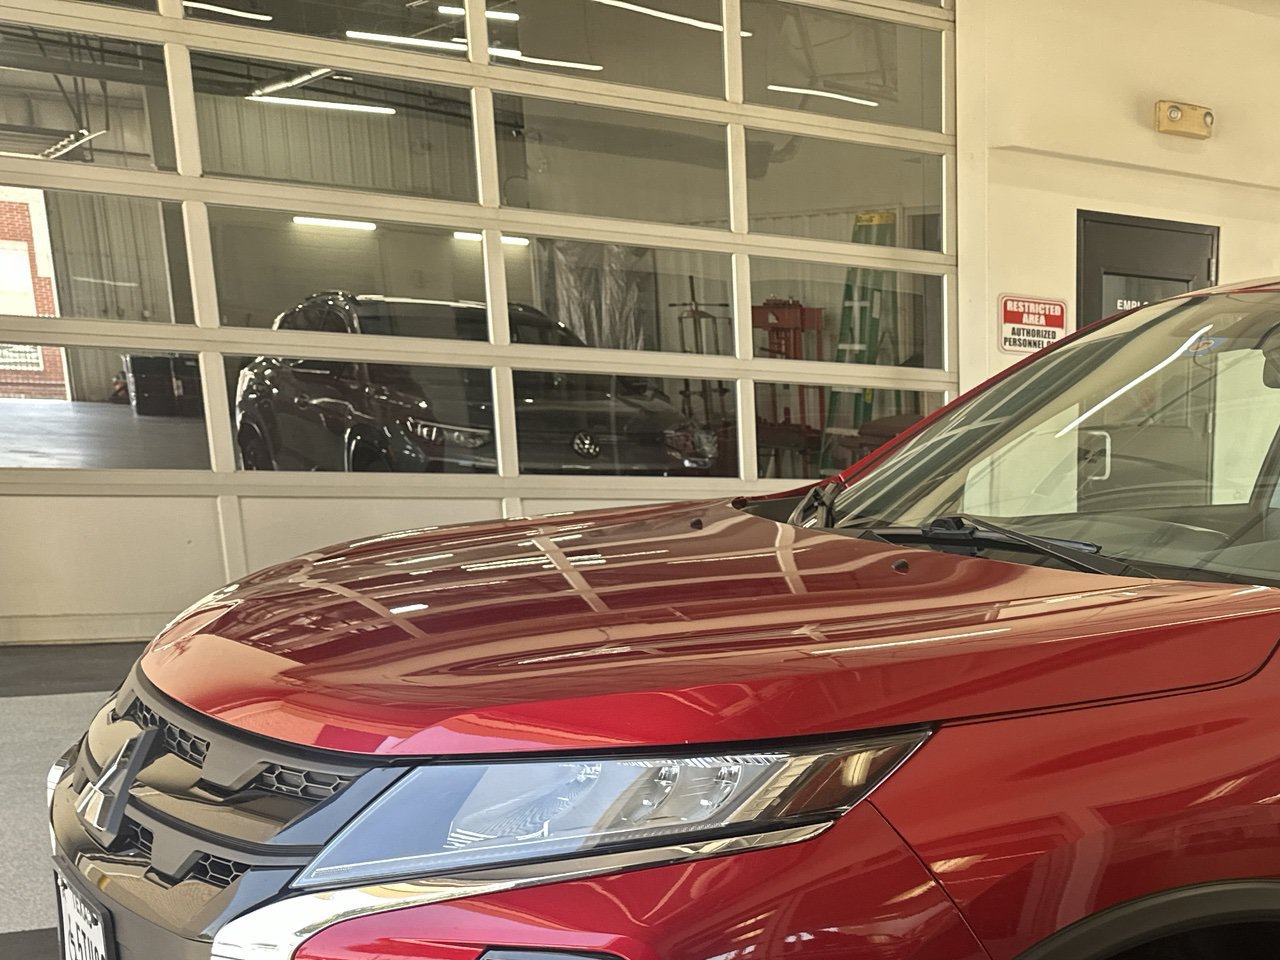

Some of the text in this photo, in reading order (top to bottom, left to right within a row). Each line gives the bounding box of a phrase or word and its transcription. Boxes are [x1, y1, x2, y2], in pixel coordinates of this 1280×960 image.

[1006, 300, 1062, 316] RESTRICTED
[1022, 313, 1046, 326] AREA
[1011, 326, 1056, 340] AUTHORIZED
[1004, 336, 1044, 349] PERSONNEL
